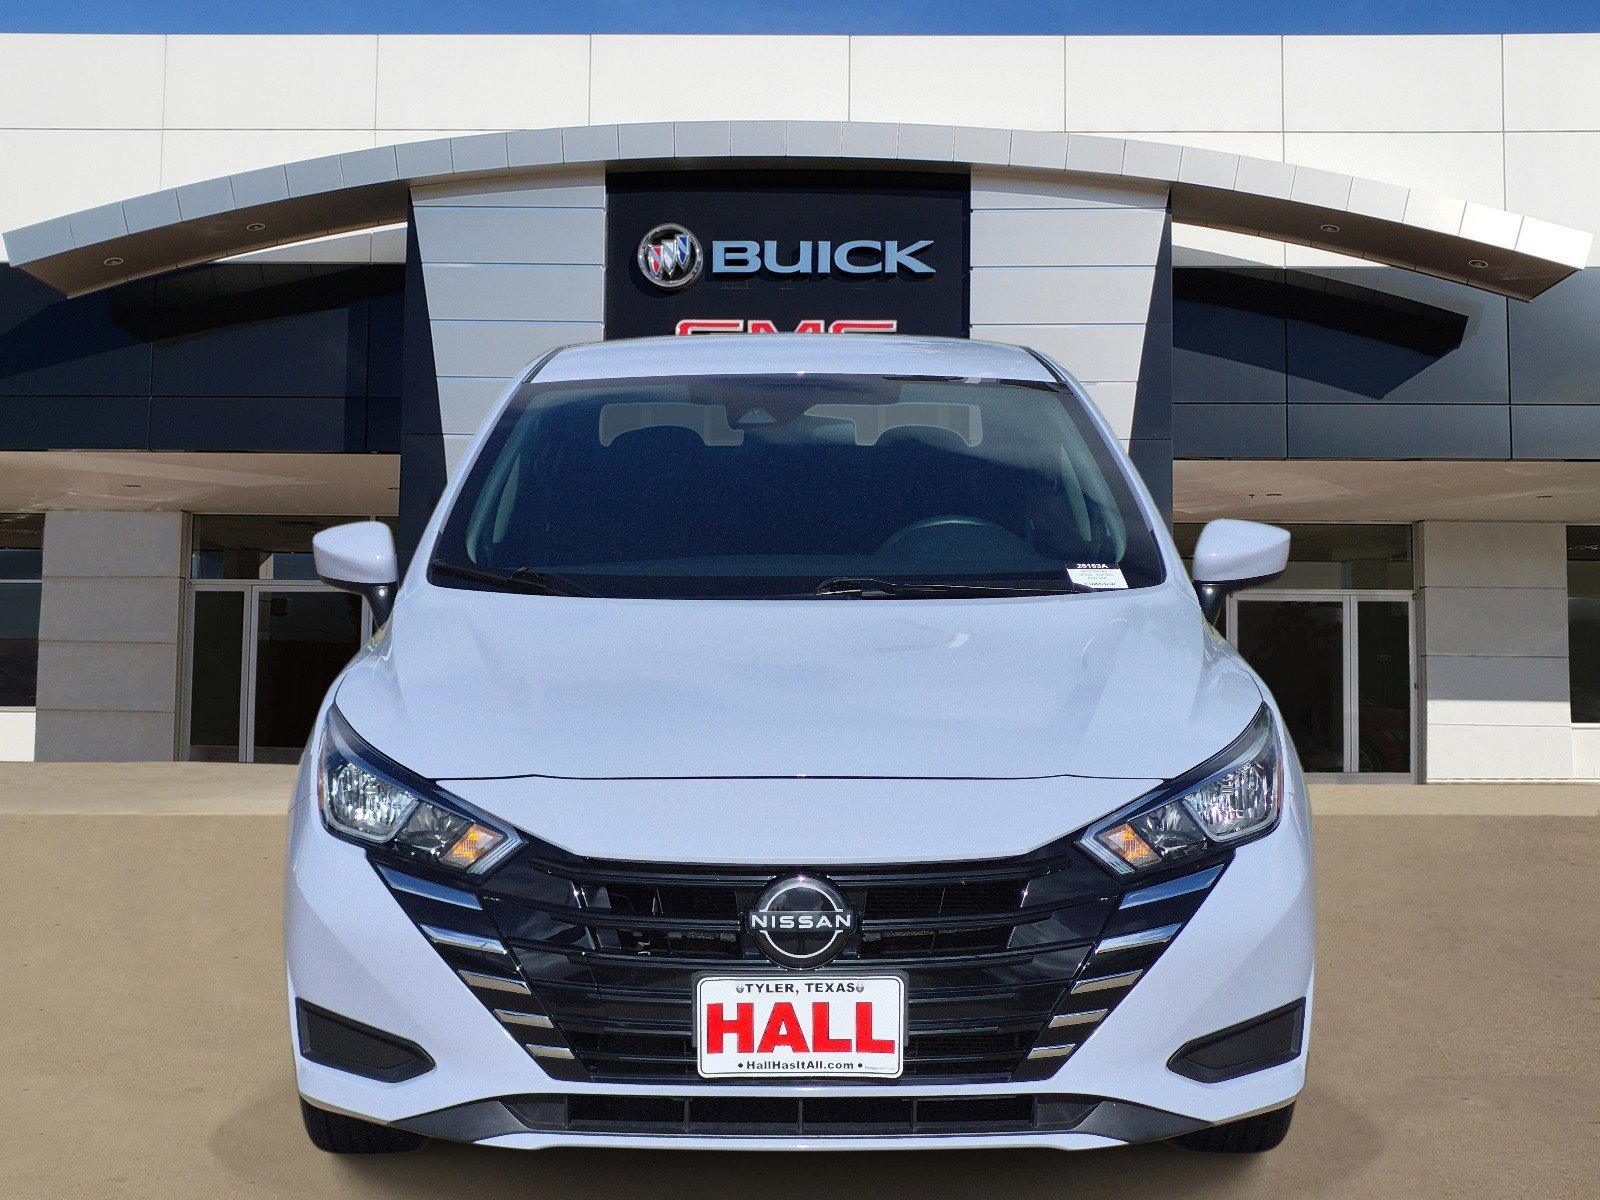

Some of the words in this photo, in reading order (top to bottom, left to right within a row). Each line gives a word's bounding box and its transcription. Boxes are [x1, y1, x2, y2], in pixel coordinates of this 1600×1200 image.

[712, 240, 936, 273] BUICK
[751, 914, 851, 929] NISSAN
[745, 983, 799, 995] TYLER,
[805, 982, 855, 993] TEXAS
[706, 1001, 895, 1054] HALL
[746, 1060, 854, 1070] HallHasItAll.com
